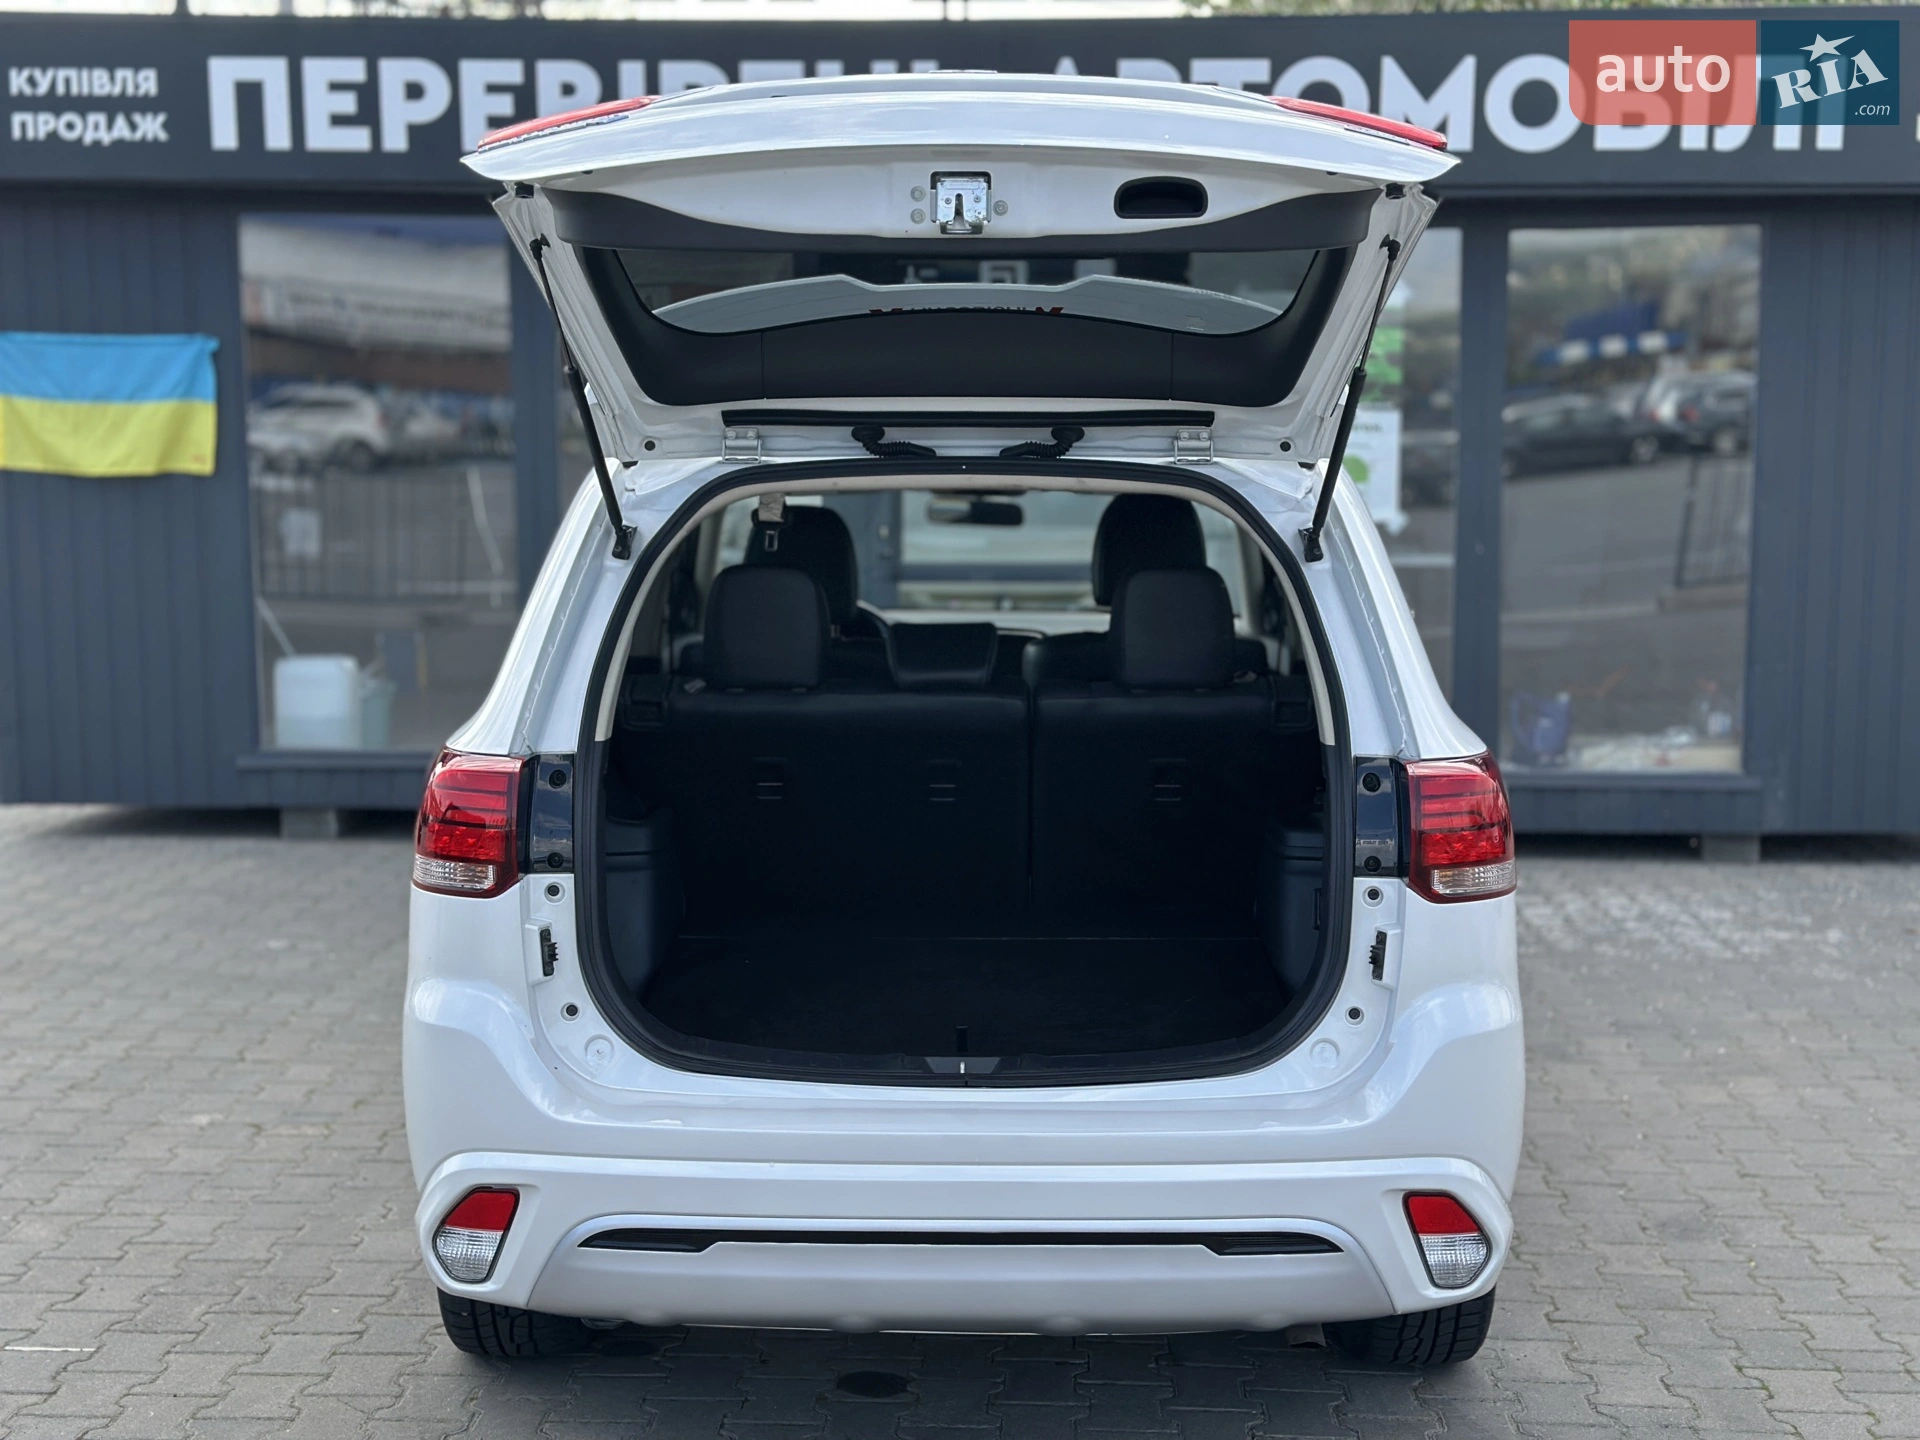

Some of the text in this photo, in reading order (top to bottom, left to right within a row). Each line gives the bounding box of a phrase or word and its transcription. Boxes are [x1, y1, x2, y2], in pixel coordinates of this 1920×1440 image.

[8, 67, 158, 97] КУПІВЛЯ
[207, 53, 1846, 153] ПЕРЕВ ОМОБІЛІ
[10, 111, 169, 146] ПРОДАЖ
